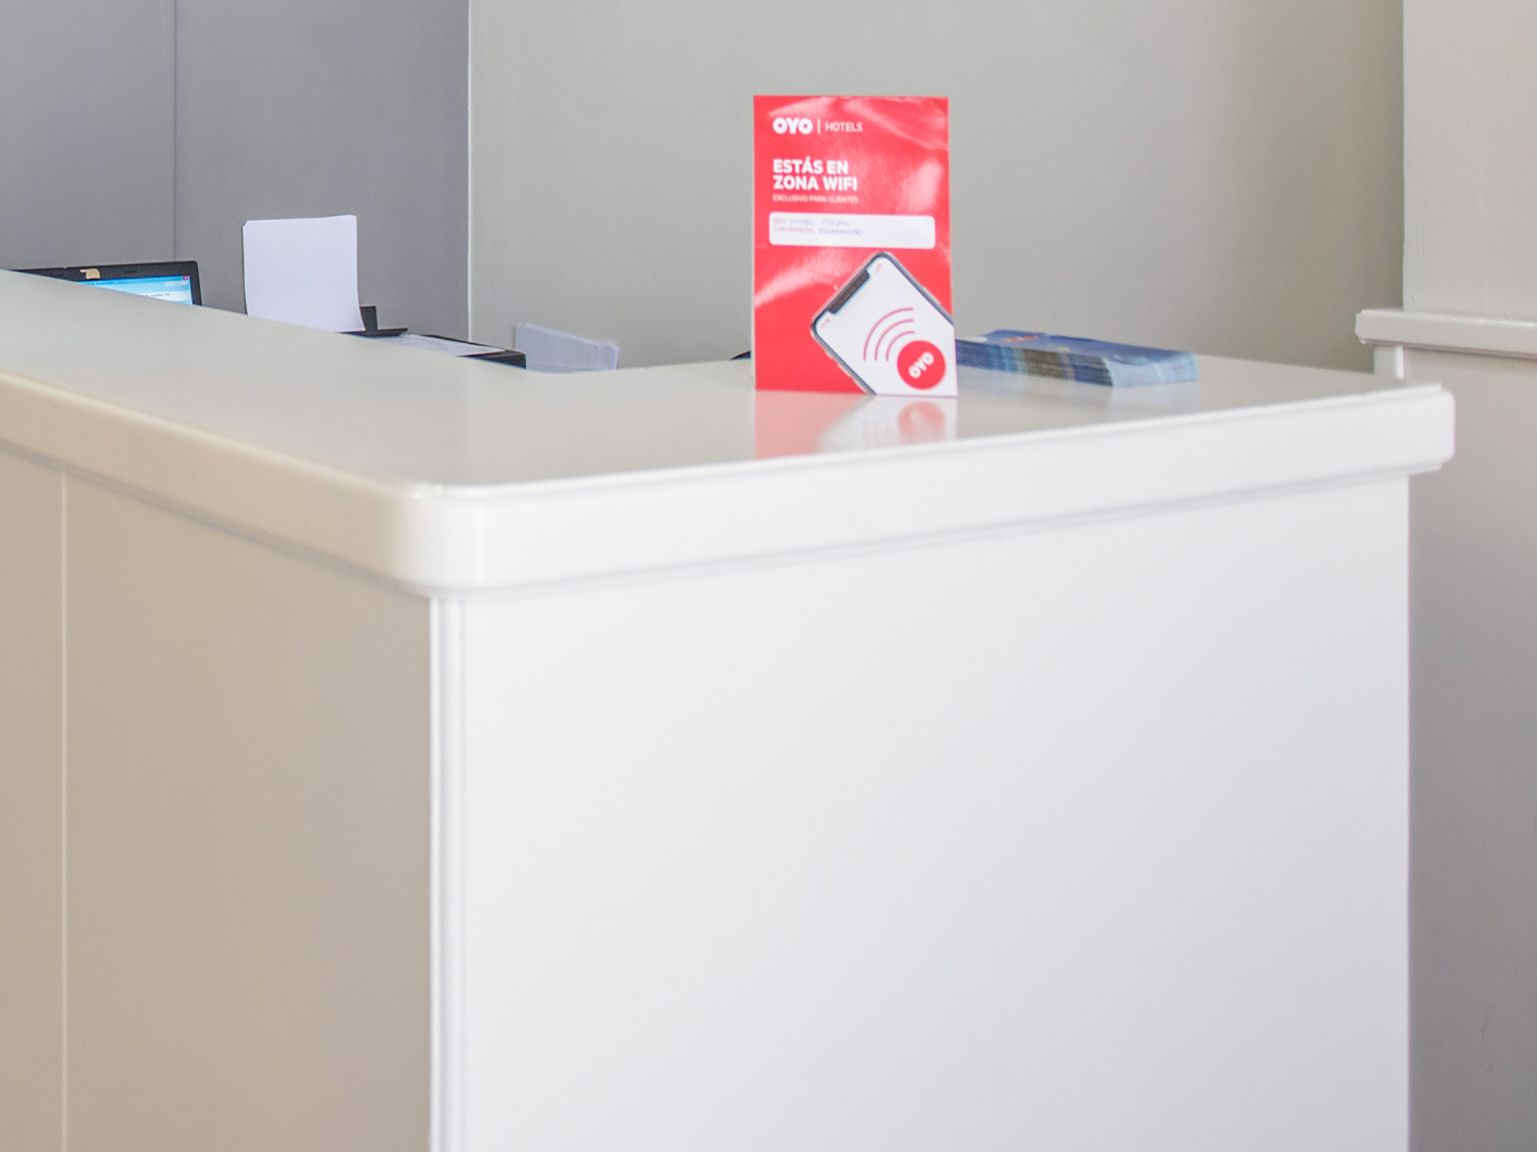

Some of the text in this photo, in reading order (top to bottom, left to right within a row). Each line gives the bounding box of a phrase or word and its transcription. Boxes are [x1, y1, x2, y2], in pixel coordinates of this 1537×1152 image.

[772, 117, 863, 135] OYO HOTELS
[773, 155, 849, 175] ESTÁS EN
[773, 175, 858, 191] ZONA WIFI
[908, 351, 934, 379] OYO
